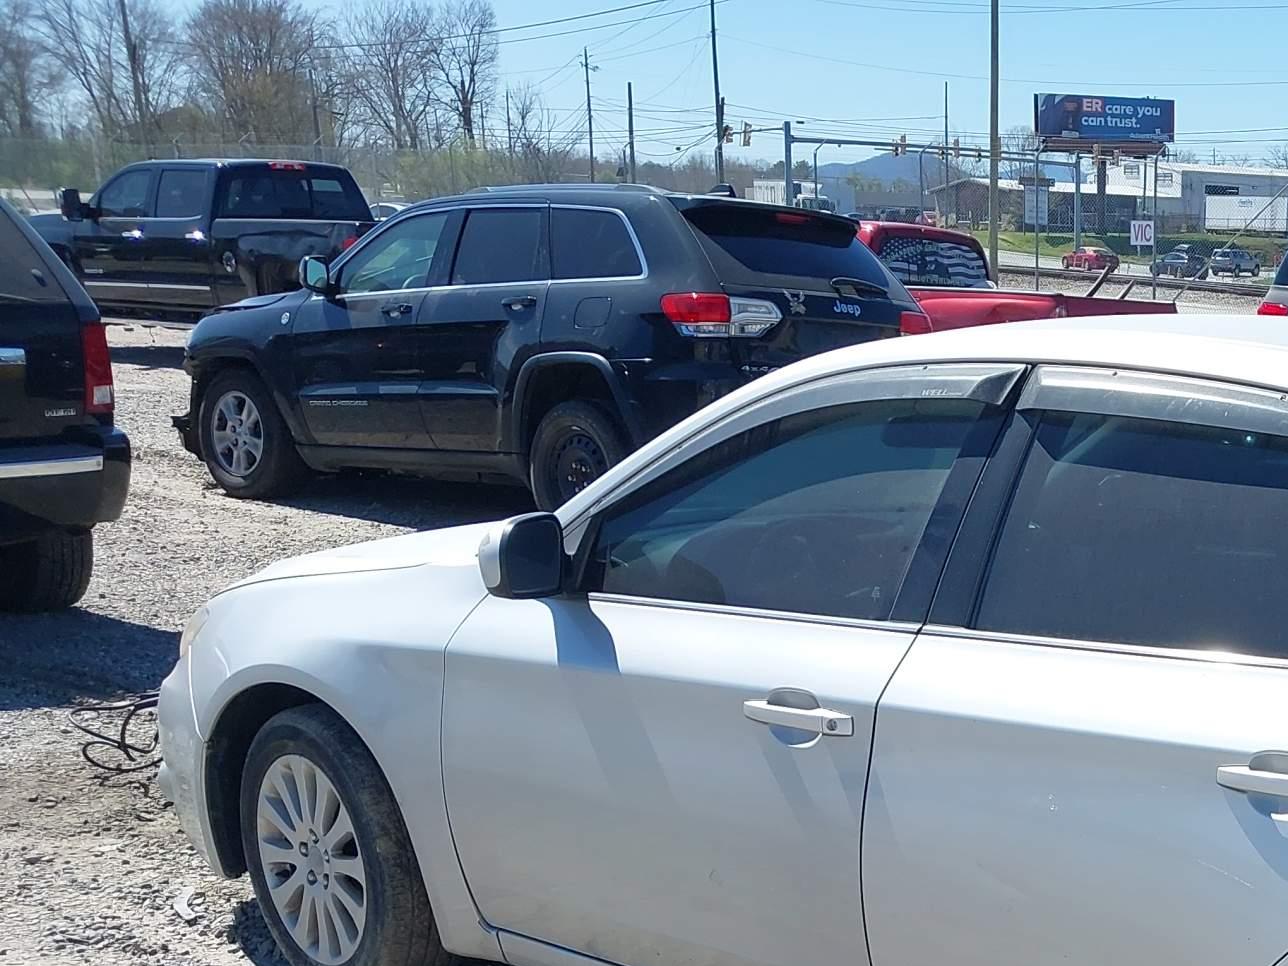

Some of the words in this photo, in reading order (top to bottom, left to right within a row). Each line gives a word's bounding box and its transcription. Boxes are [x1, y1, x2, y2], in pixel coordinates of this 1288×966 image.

[1083, 99, 1102, 112] ER
[1105, 104, 1134, 114] care
[1137, 106, 1161, 118] you
[1081, 116, 1105, 126] can
[1106, 115, 1141, 128] trust.
[1132, 223, 1152, 242] VIC
[833, 299, 861, 317] Jeep
